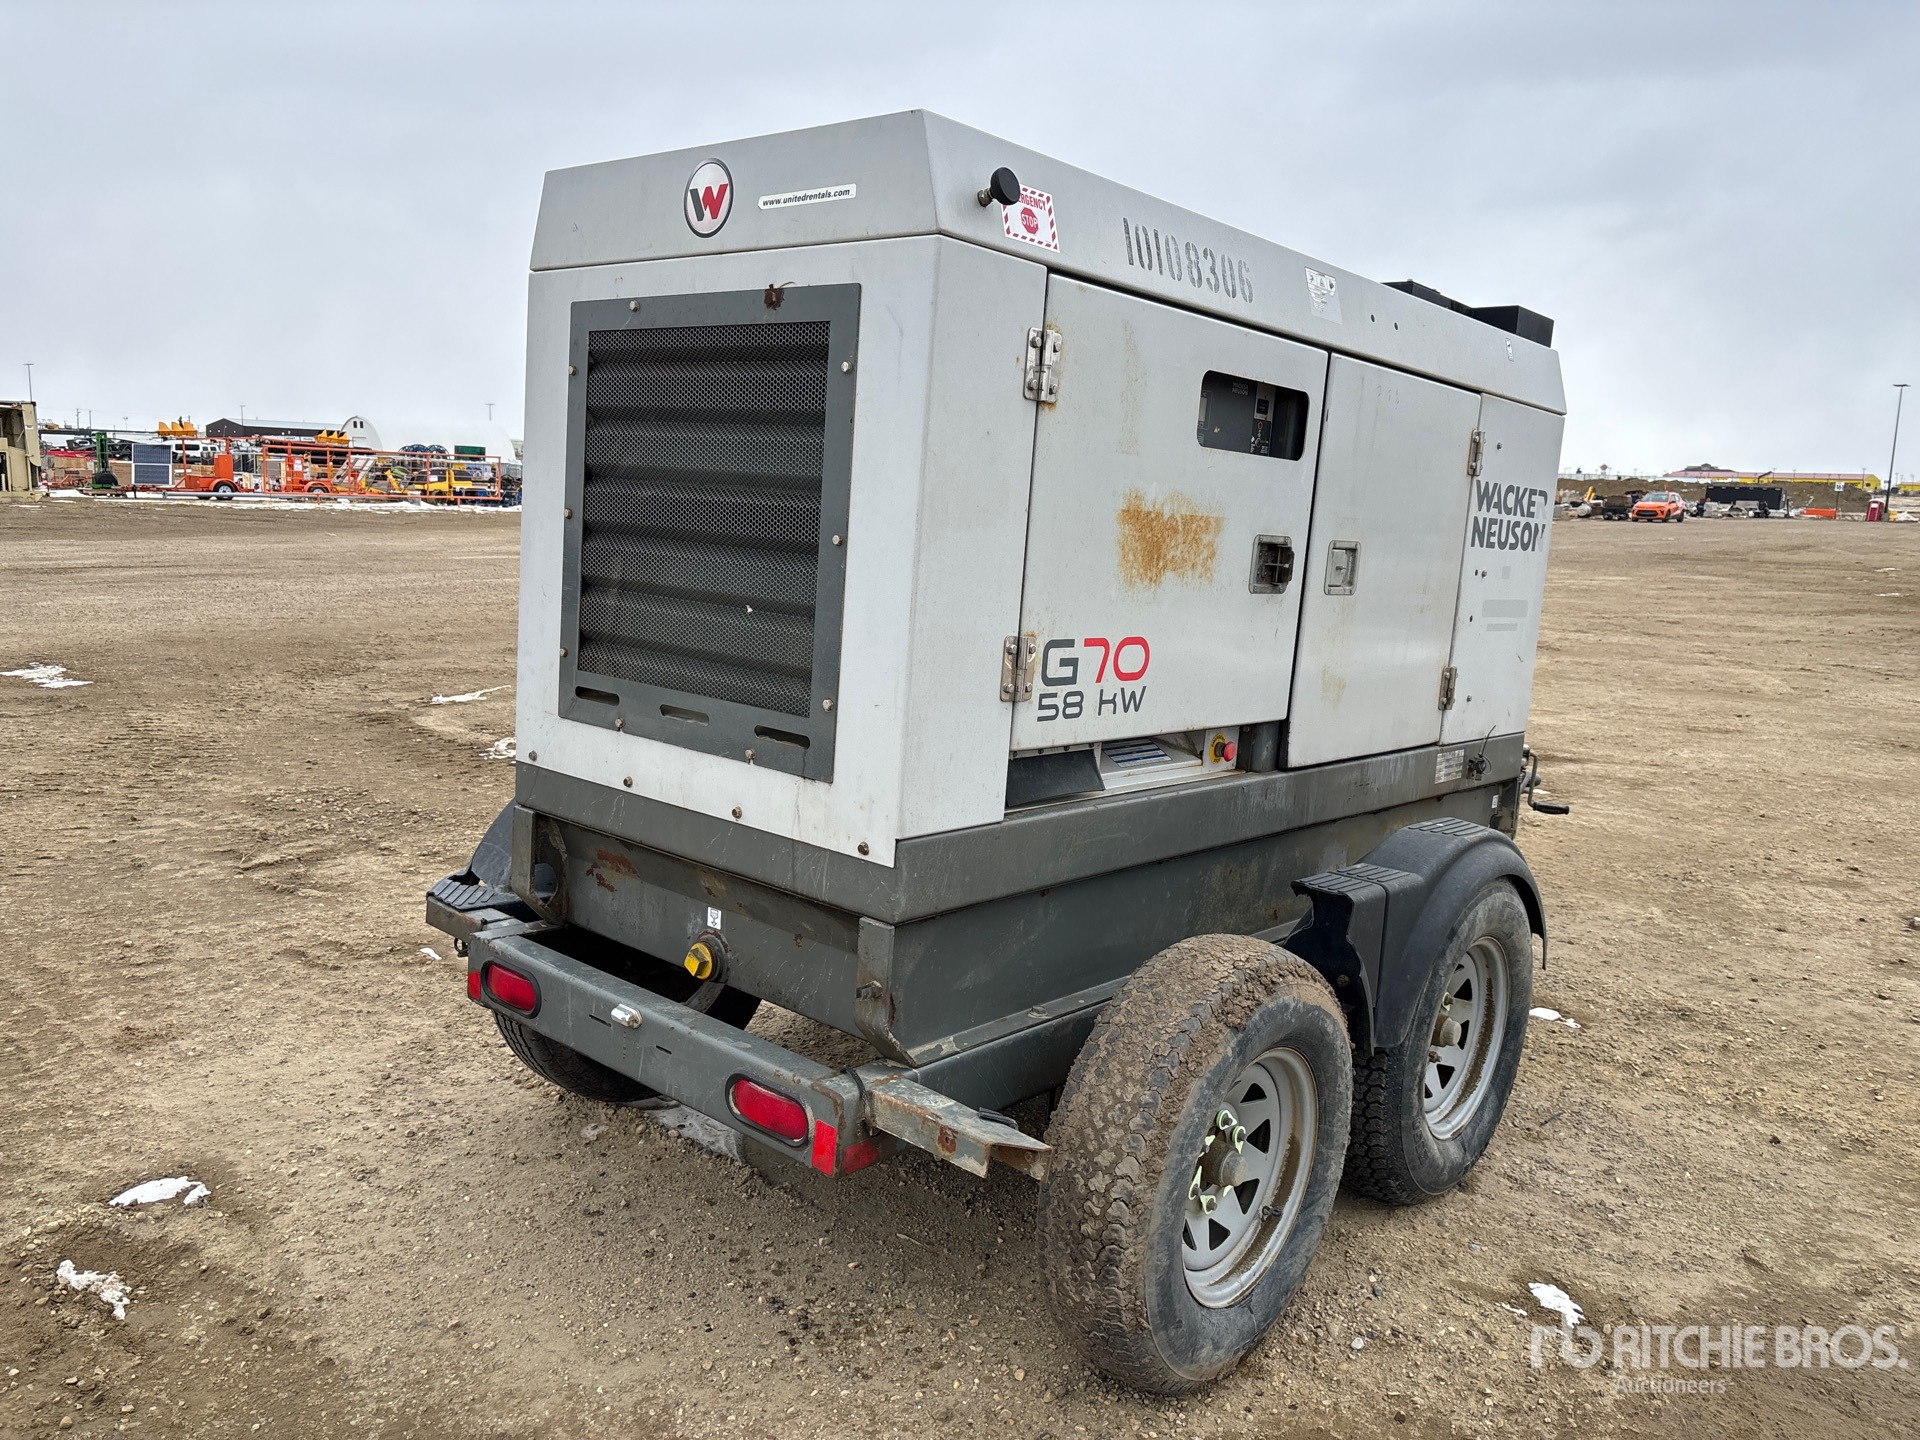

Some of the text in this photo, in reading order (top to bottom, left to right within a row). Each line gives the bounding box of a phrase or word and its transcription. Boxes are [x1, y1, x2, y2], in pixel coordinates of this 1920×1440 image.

[762, 188, 850, 206] www.unitedrentals.com
[1021, 213, 1038, 229] STOP
[1041, 636, 1150, 687] G70
[1037, 690, 1084, 722] 58
